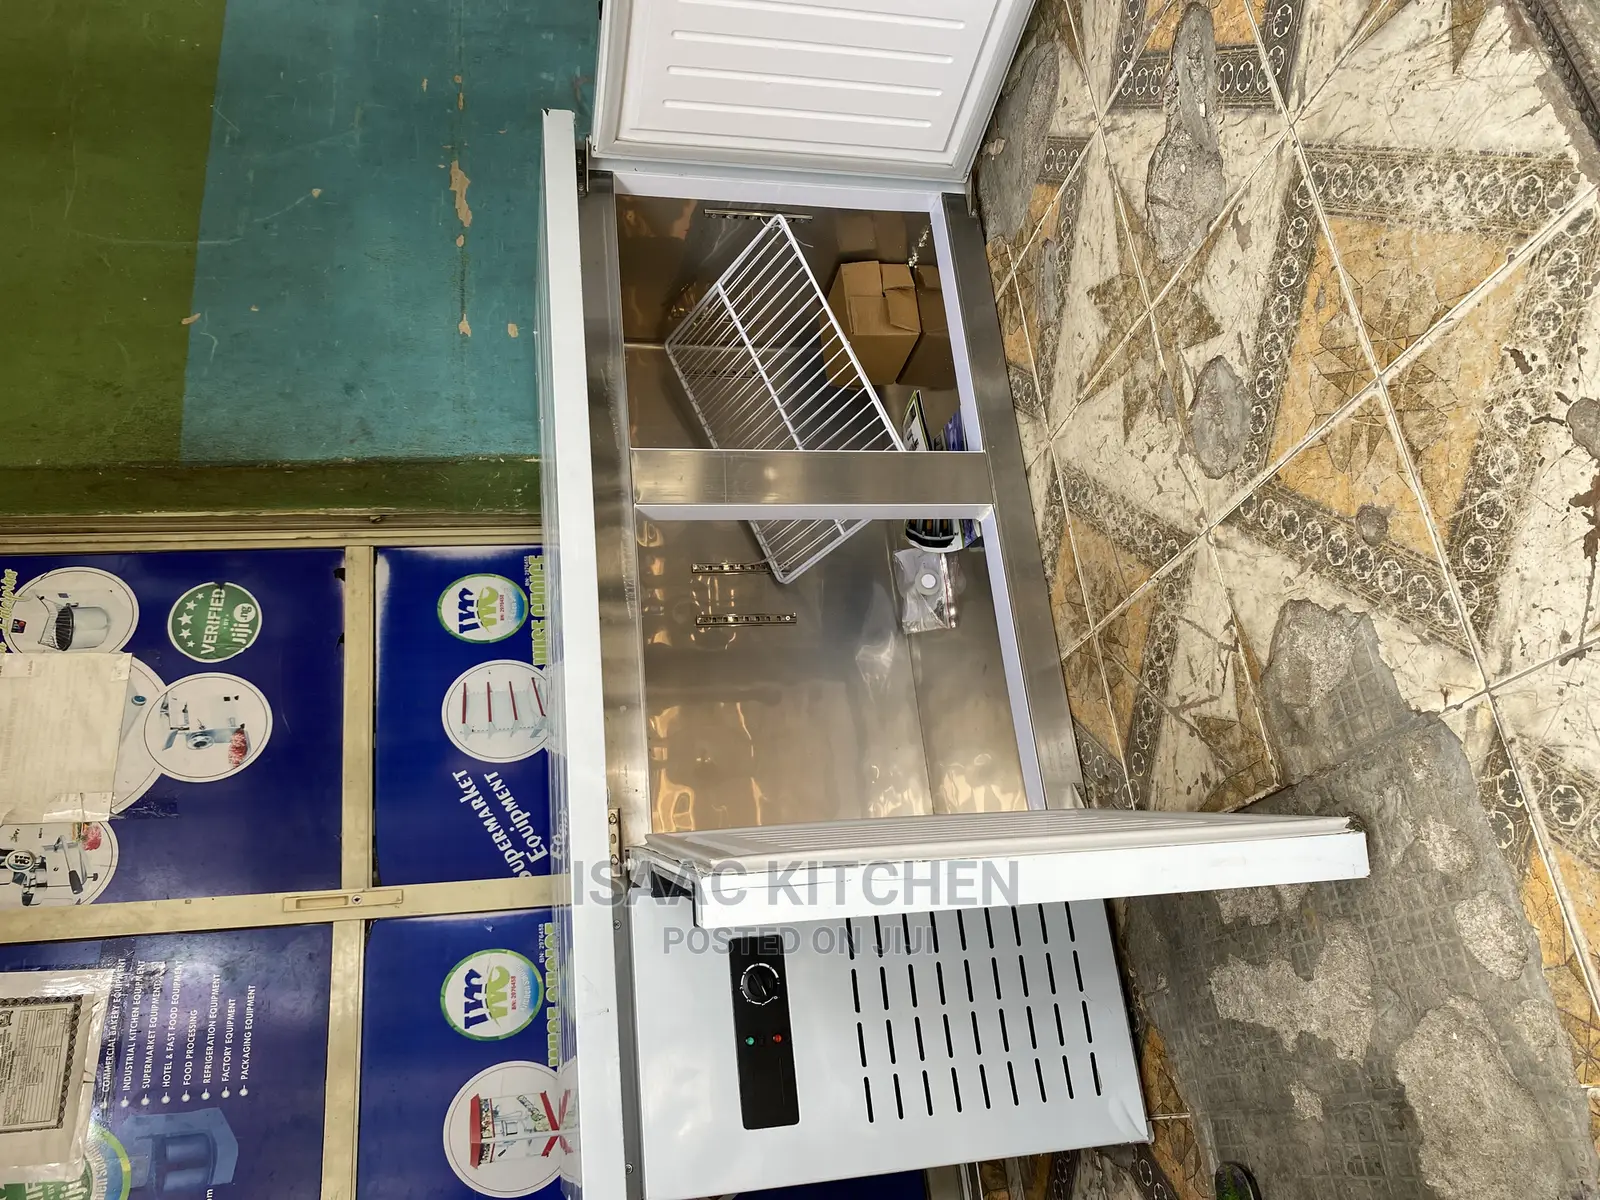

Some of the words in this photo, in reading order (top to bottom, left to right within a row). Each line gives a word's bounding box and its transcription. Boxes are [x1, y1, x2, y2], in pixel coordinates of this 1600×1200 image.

[200, 589, 225, 654] VERIFIED
[113, 958, 126, 1002] EQUIPMENT
[133, 960, 145, 1005] EQUIPMENT
[171, 960, 183, 1005] EQUIPMENT
[109, 1005, 120, 1035] BAKERY
[129, 1007, 139, 1040] KITCHEN
[169, 1007, 178, 1030] FOOD
[203, 1021, 216, 1084] REFRIGERATION
[210, 974, 220, 1018] EQUIPMENT
[225, 999, 235, 1044] EQUIPMENT
[245, 985, 255, 1029] EQUIPMENT
[142, 1030, 155, 1088] SUPERMARKET
[149, 983, 161, 1028] EQUIPMENT
[166, 1032, 175, 1051] FAST
[186, 1010, 198, 1059] PROCESSING
[241, 1032, 252, 1080] PACKAGING
[102, 1037, 116, 1092] COMMERCIAL
[122, 1043, 135, 1091] INDUSTRIAL
[162, 1062, 173, 1087] HOTEL
[183, 1061, 192, 1085] FOOD
[222, 1046, 231, 1082] FACTORY
